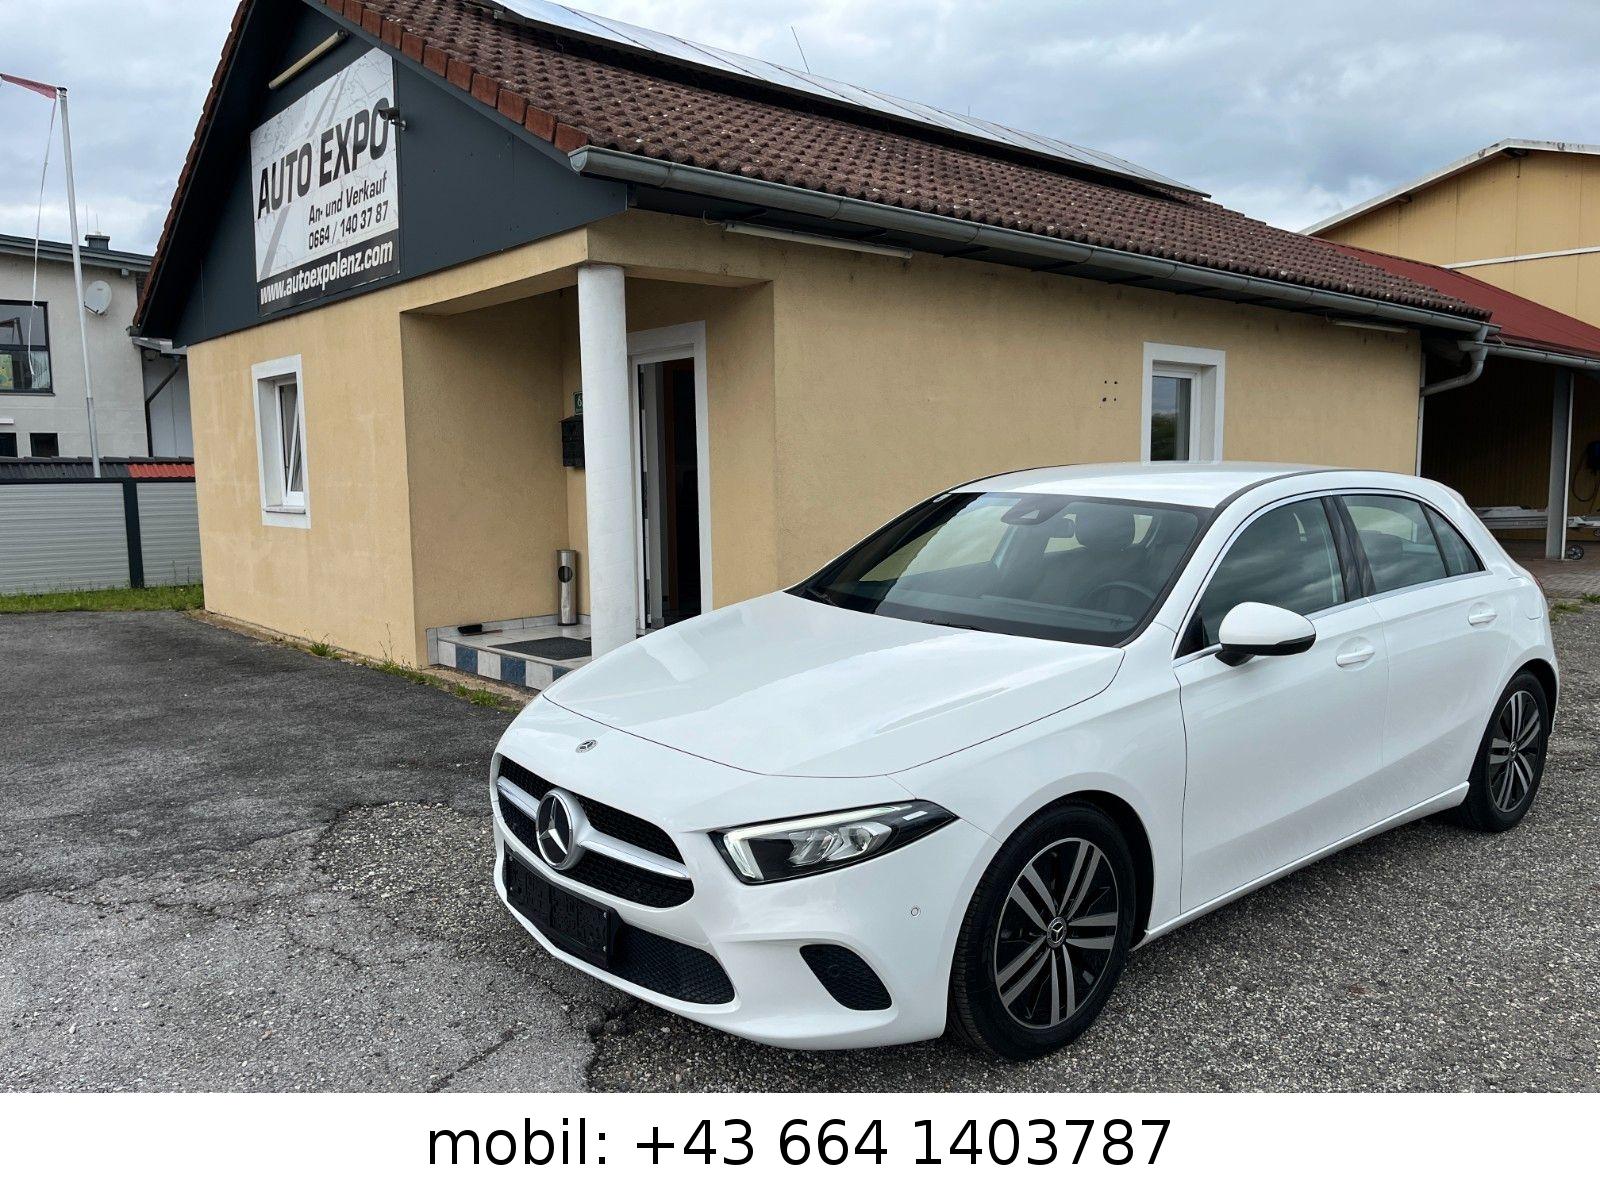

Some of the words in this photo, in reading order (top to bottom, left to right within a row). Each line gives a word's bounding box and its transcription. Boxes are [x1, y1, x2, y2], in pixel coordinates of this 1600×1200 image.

[257, 142, 312, 220] AUTO
[319, 97, 390, 187] EXPO
[308, 204, 323, 226] An-
[325, 191, 343, 216] und
[346, 170, 388, 209] Verkauf
[308, 225, 330, 250] 0664
[340, 213, 358, 237] 140
[360, 206, 373, 229] 37
[375, 200, 389, 223] 87
[260, 240, 393, 305] www.autoexpolenz.com
